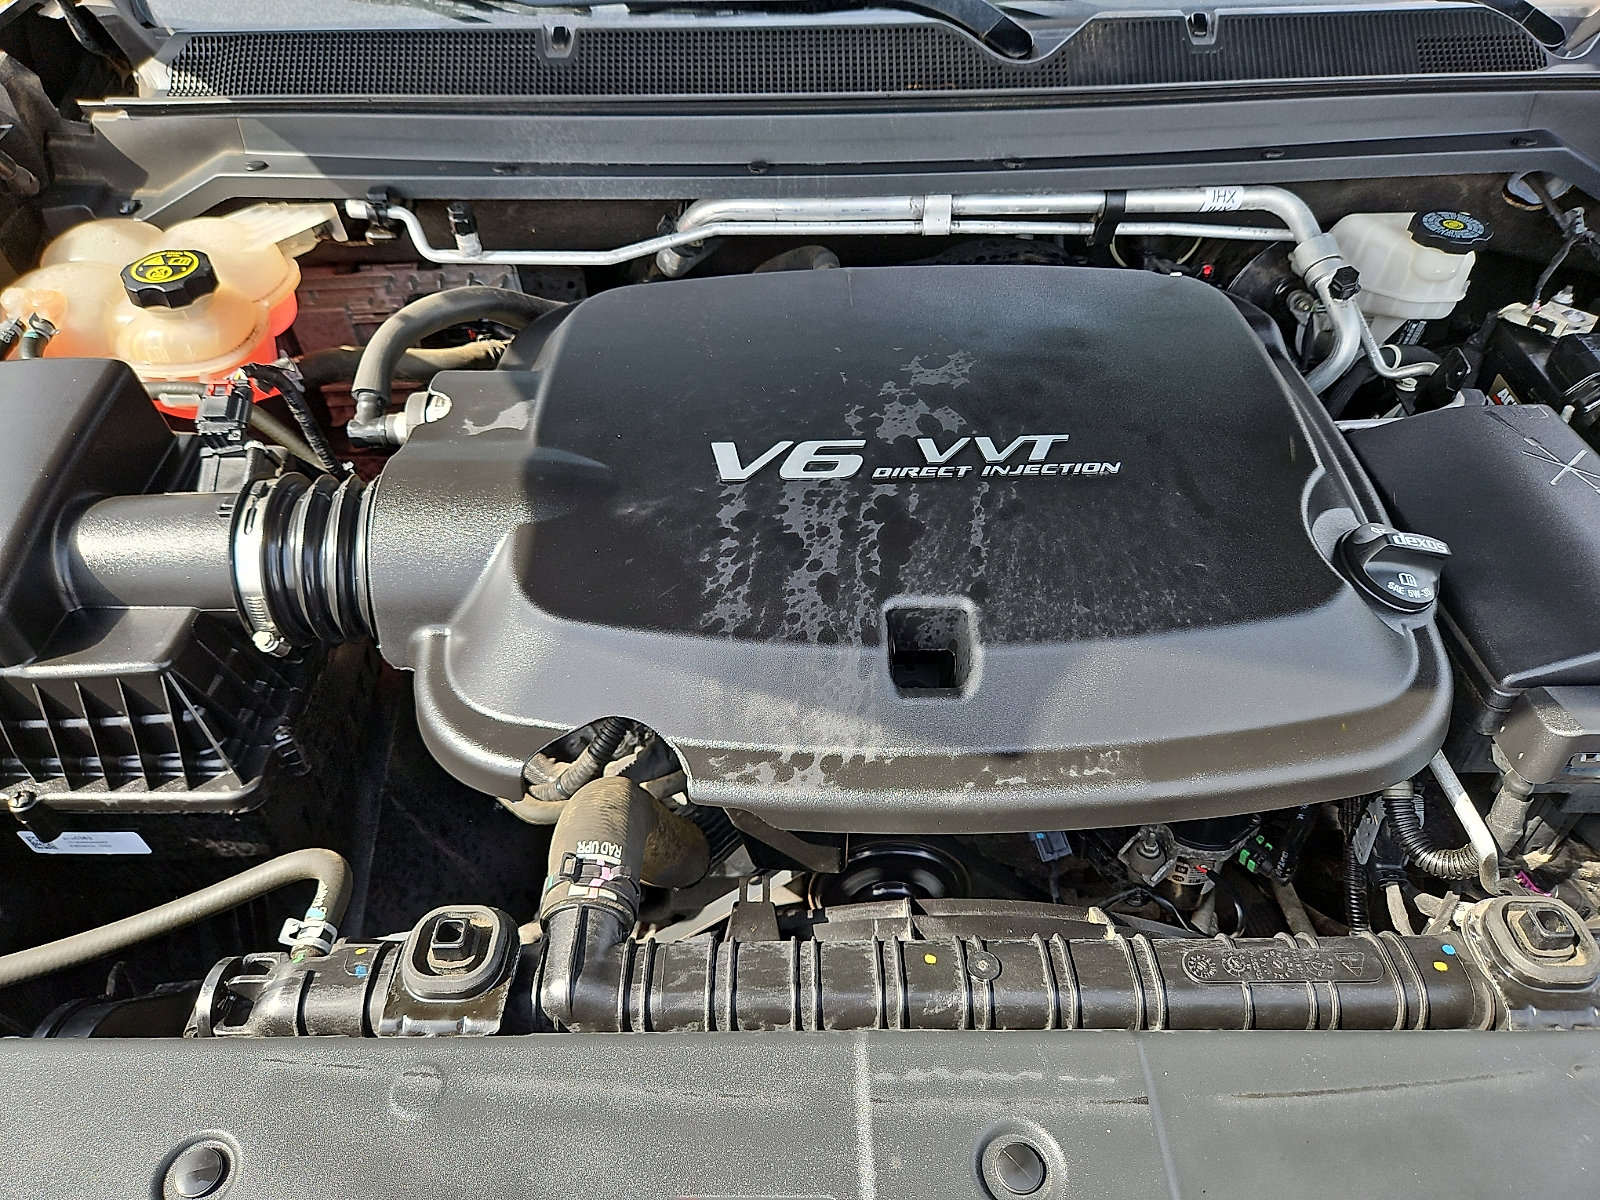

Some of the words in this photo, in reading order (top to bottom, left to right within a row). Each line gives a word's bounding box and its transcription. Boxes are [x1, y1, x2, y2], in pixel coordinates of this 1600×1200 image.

[916, 434, 1070, 464] VVT
[710, 439, 867, 481] V6
[872, 465, 973, 479] DIRECT
[981, 462, 1122, 477] INJECTION
[1392, 532, 1449, 554] dexos
[1387, 581, 1406, 596] SAE
[576, 840, 600, 854] UPR
[600, 841, 623, 859] RAD
